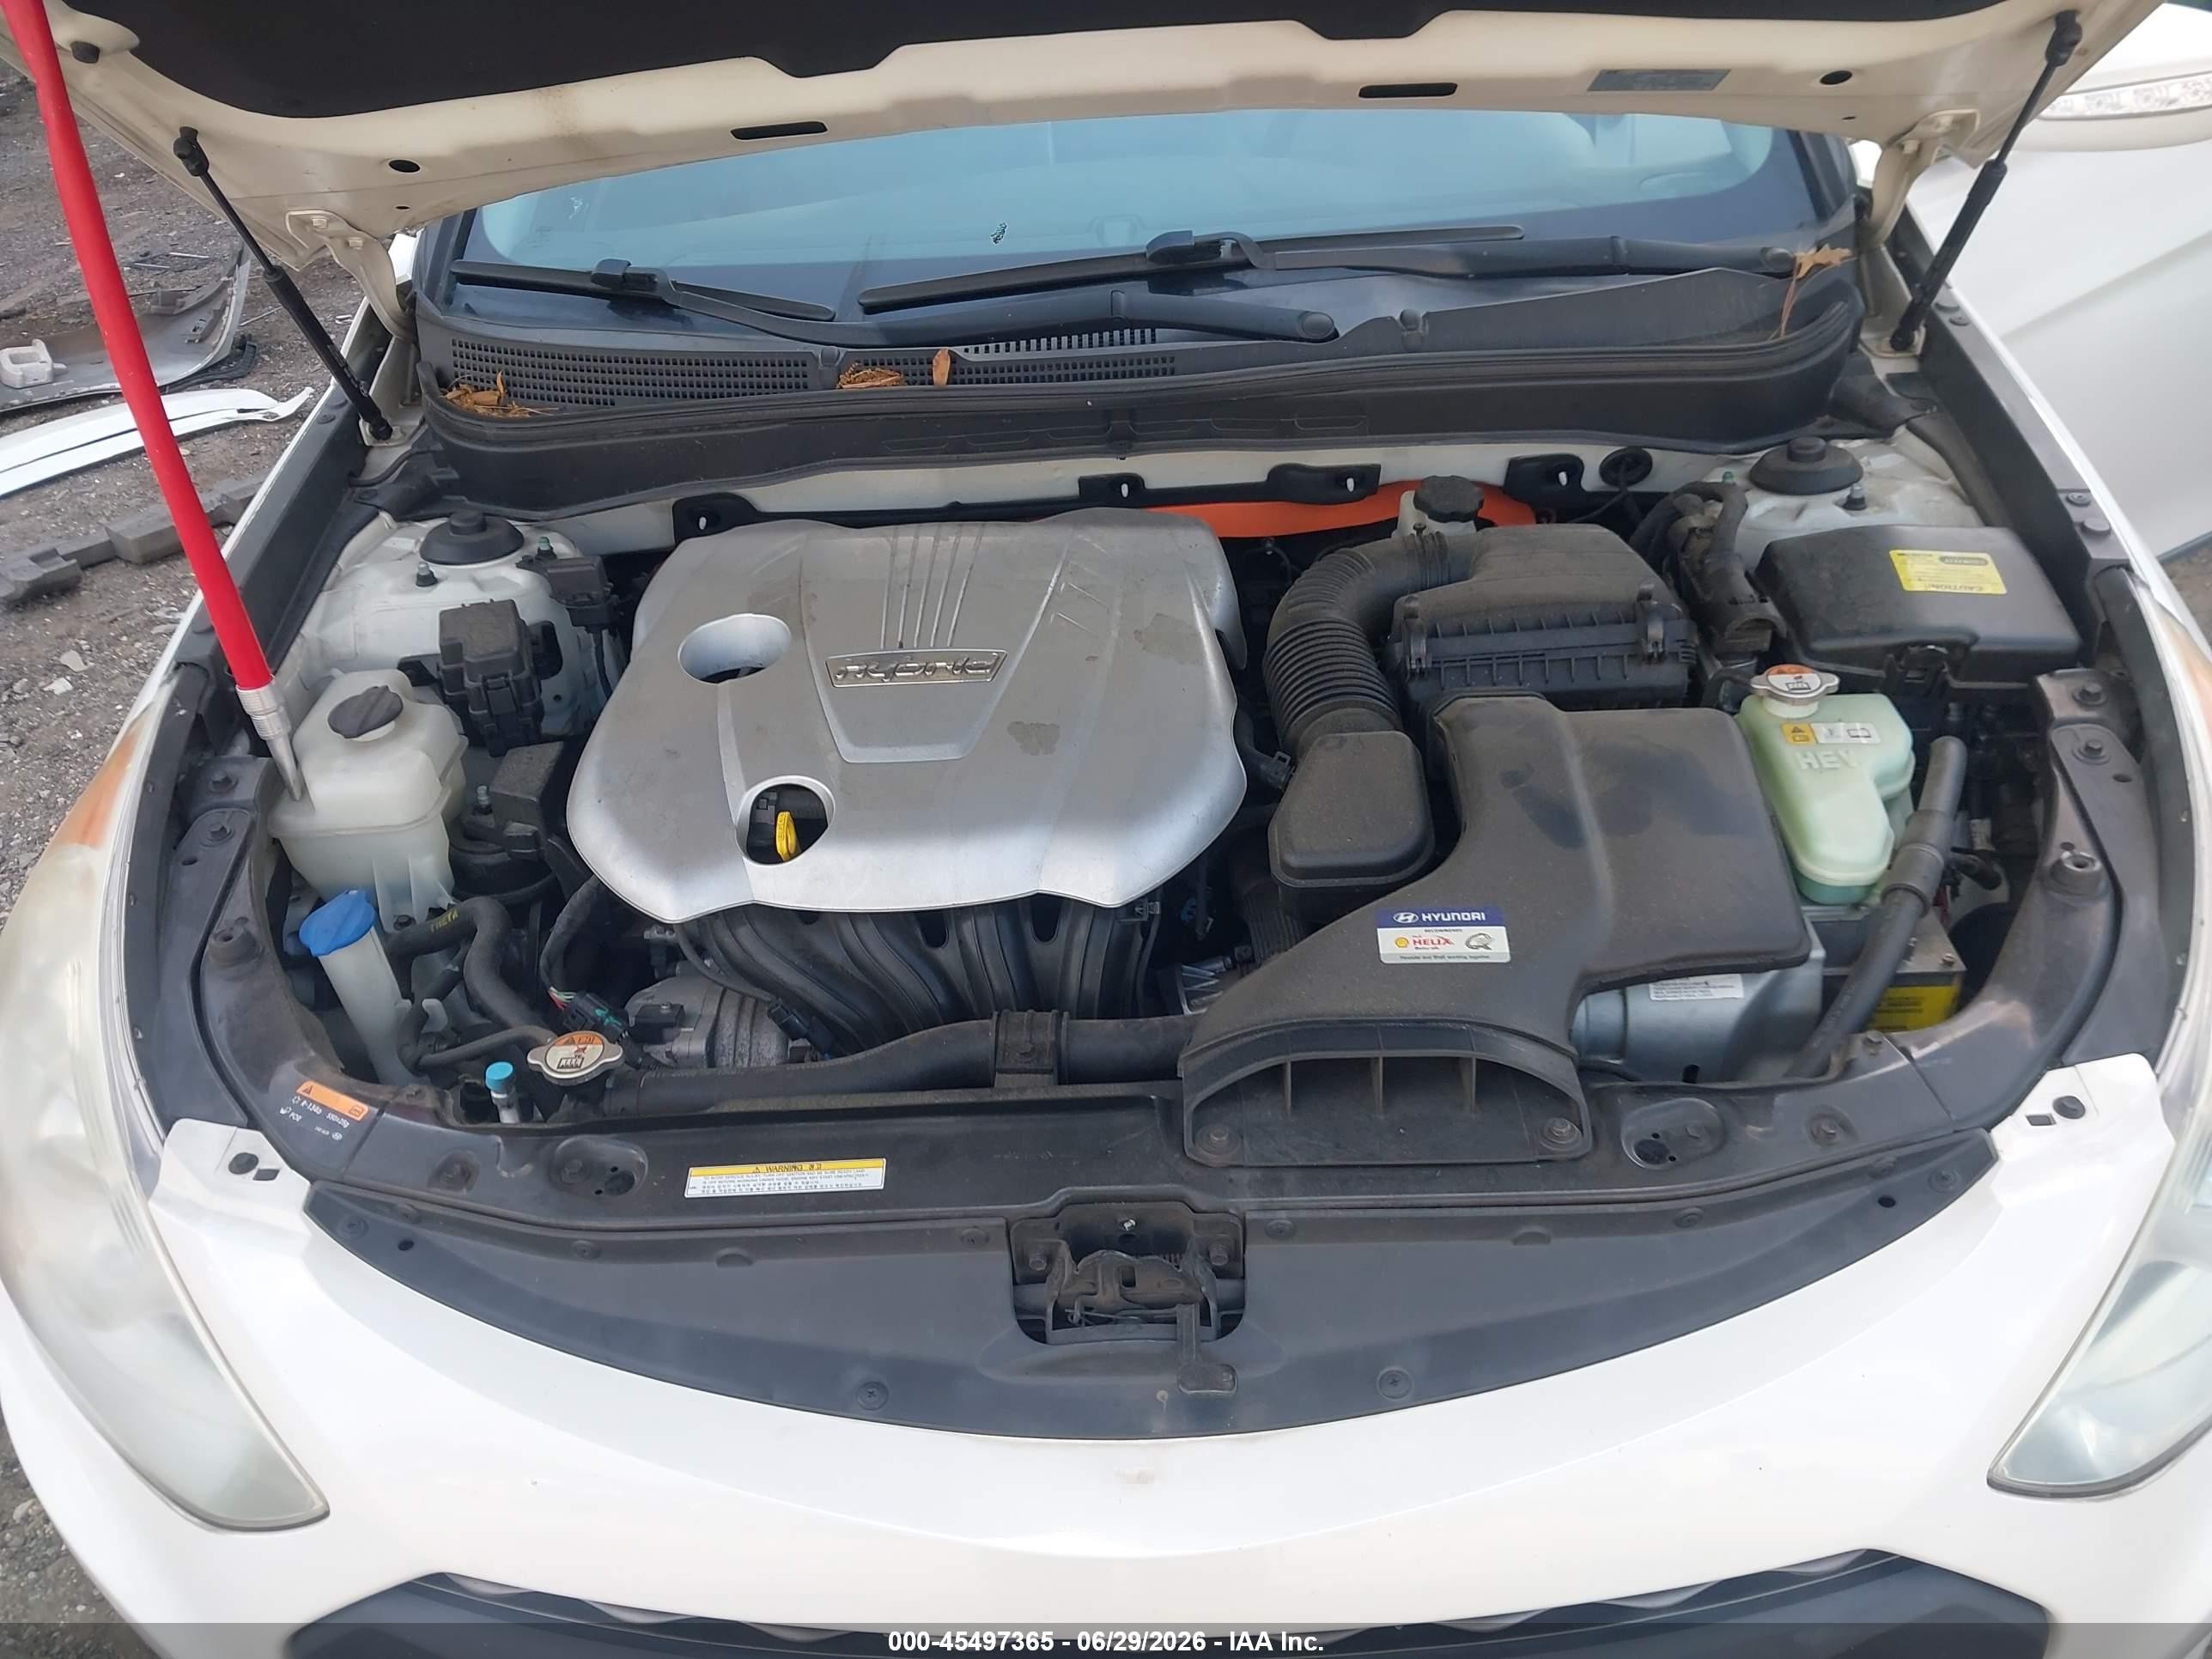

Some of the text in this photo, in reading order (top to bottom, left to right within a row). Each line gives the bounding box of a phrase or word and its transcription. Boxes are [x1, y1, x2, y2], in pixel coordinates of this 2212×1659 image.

[1796, 749, 1859, 770] HEV
[1421, 911, 1486, 923] HYUNDAI
[1413, 937, 1453, 945] HELIX
[766, 1164, 804, 1174] WARNING
